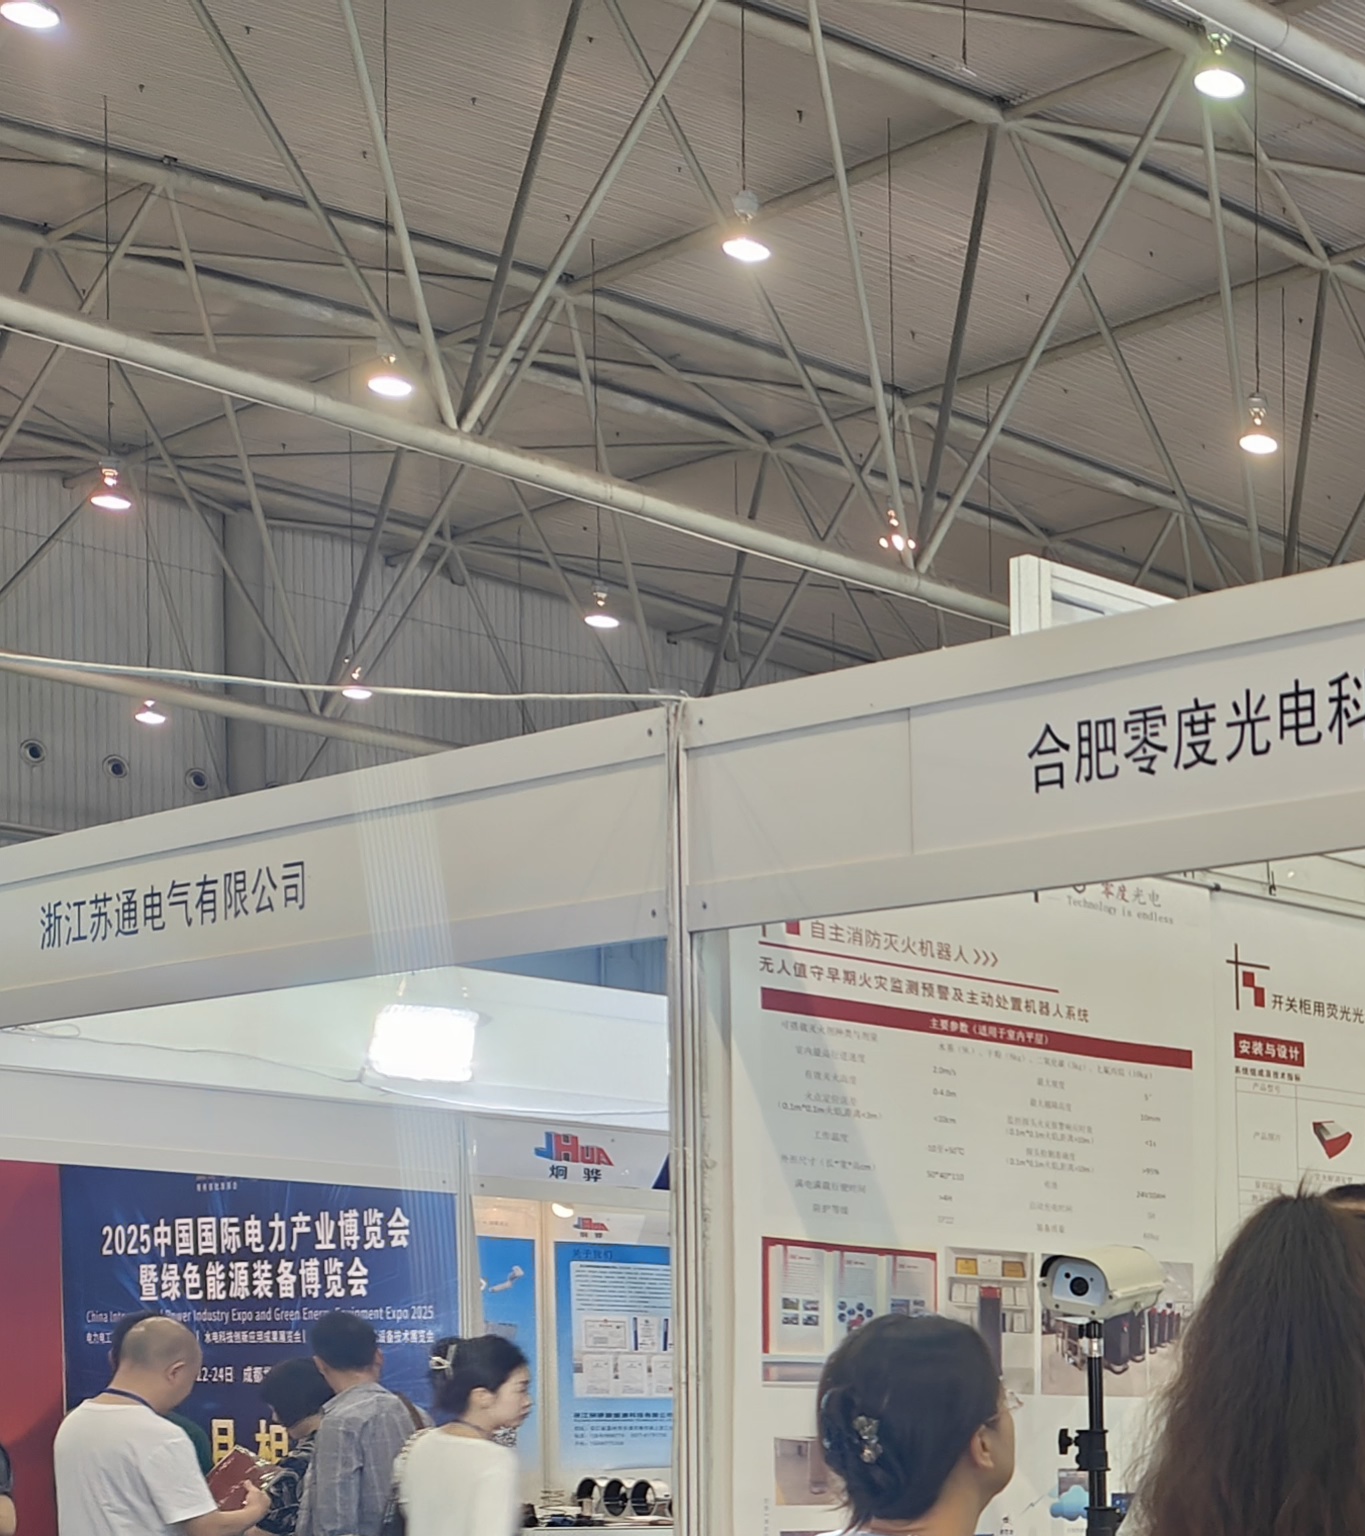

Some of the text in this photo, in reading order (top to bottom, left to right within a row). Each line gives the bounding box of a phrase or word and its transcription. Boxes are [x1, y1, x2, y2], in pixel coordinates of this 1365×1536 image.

[40, 861, 307, 950] 浙江苏通电气有限公司
[1067, 895, 1174, 925] Technology is endless
[1101, 882, 1161, 908] 零度光电
[811, 920, 970, 964] 自主消防灭火机器人
[759, 956, 1089, 1023] 无人值守早期火灾监测预警及主动处置机器人系统
[1239, 1037, 1301, 1061] 安装与设计
[101, 1206, 410, 1257] 2025中国国际电力产业博览会
[139, 1257, 369, 1301] 暨绿色能源装备博览会
[86, 1311, 108, 1323] China
[194, 1308, 229, 1324] Industry
[231, 1308, 254, 1323] Expo
[255, 1307, 272, 1321] and
[274, 1307, 299, 1321] Green
[386, 1307, 408, 1323] Expo
[411, 1305, 434, 1319] 2025
